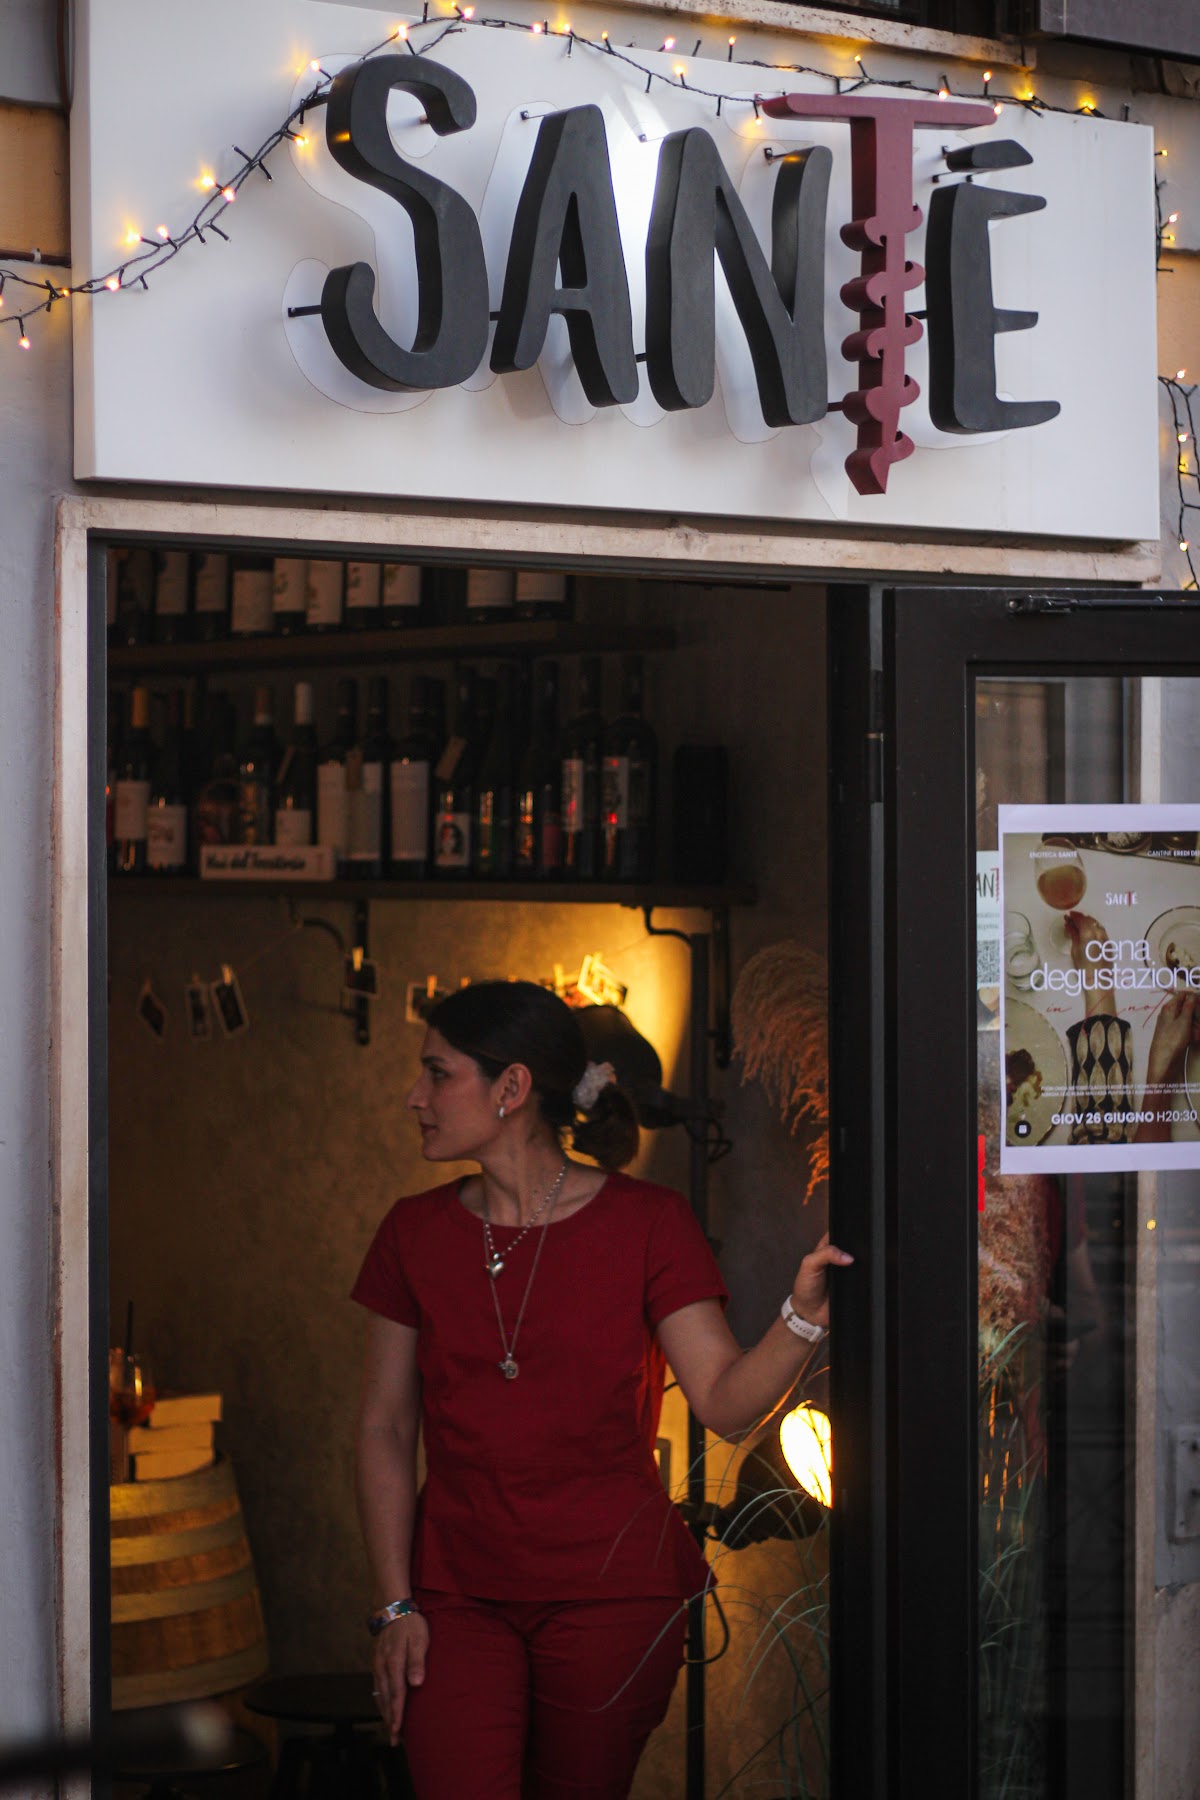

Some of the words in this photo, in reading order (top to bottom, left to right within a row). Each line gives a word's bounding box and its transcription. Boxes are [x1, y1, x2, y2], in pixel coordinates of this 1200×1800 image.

[321, 55, 1061, 495] SANTÉ
[1084, 939, 1151, 962] cena
[1029, 962, 1200, 996] degustazione
[1051, 1112, 1084, 1125] GIOV
[1086, 1111, 1101, 1124] 26
[1103, 1111, 1154, 1124] GIUGNO
[1156, 1110, 1198, 1122] H20:30
